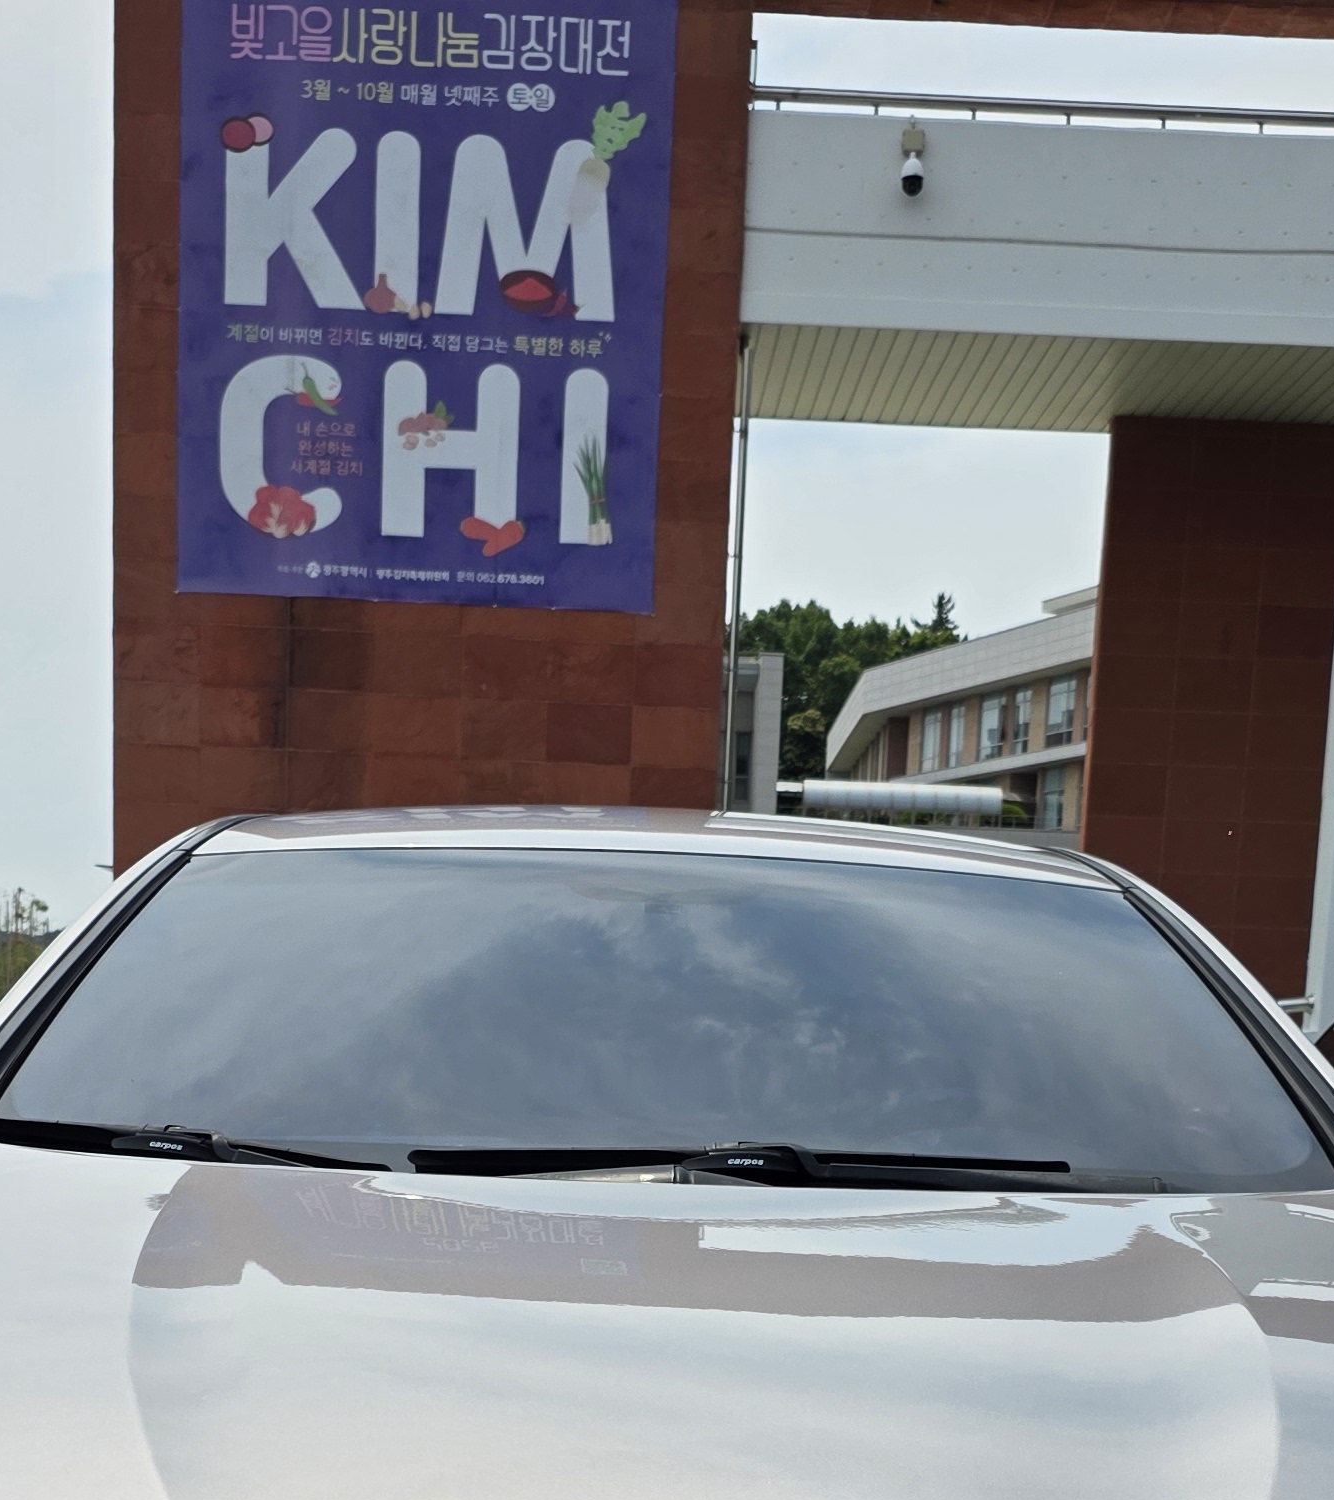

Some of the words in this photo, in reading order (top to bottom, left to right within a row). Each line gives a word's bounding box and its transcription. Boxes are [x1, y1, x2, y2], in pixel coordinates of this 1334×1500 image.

[300, 79, 331, 101] 3월
[356, 82, 394, 104] 10월
[400, 84, 437, 106] 매월
[444, 85, 500, 107] 넷째주
[224, 127, 615, 322] KIM
[227, 323, 274, 344] 계절이
[279, 327, 322, 346] 바뀌면
[328, 327, 374, 347] 김치도
[432, 333, 461, 352] 직접
[465, 335, 509, 354] 담그는
[514, 336, 563, 357] 특별한
[569, 337, 604, 359] 하루
[296, 421, 310, 437] 내
[316, 421, 357, 437] 손으로
[219, 354, 610, 544] CHI
[299, 440, 354, 457] 완성하는
[336, 459, 363, 477] 김치
[727, 1158, 764, 1166] carpos
